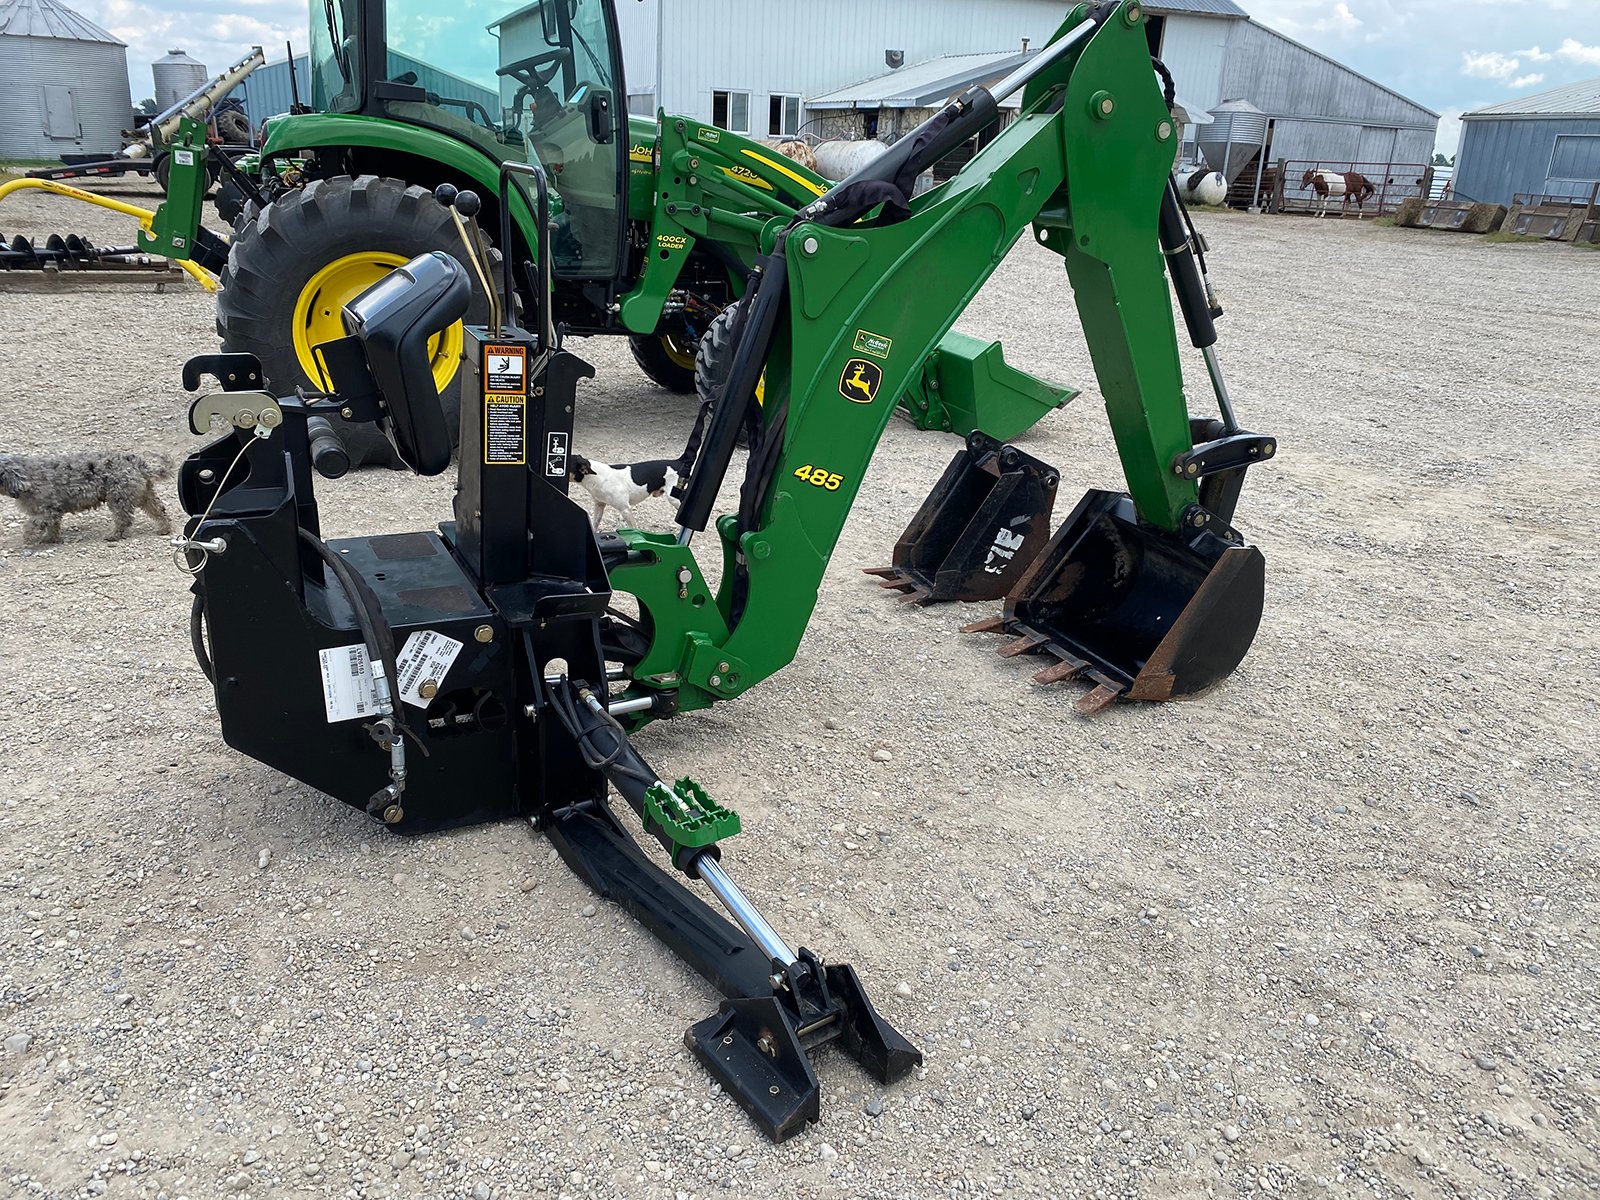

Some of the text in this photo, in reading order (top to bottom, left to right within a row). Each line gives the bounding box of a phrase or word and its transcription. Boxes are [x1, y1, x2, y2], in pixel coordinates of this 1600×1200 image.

[629, 144, 653, 156] JOH
[731, 165, 758, 179] 4720
[816, 183, 828, 193] JO
[656, 235, 687, 244] 400CX
[495, 347, 524, 355] WARNING
[793, 464, 845, 492] 485
